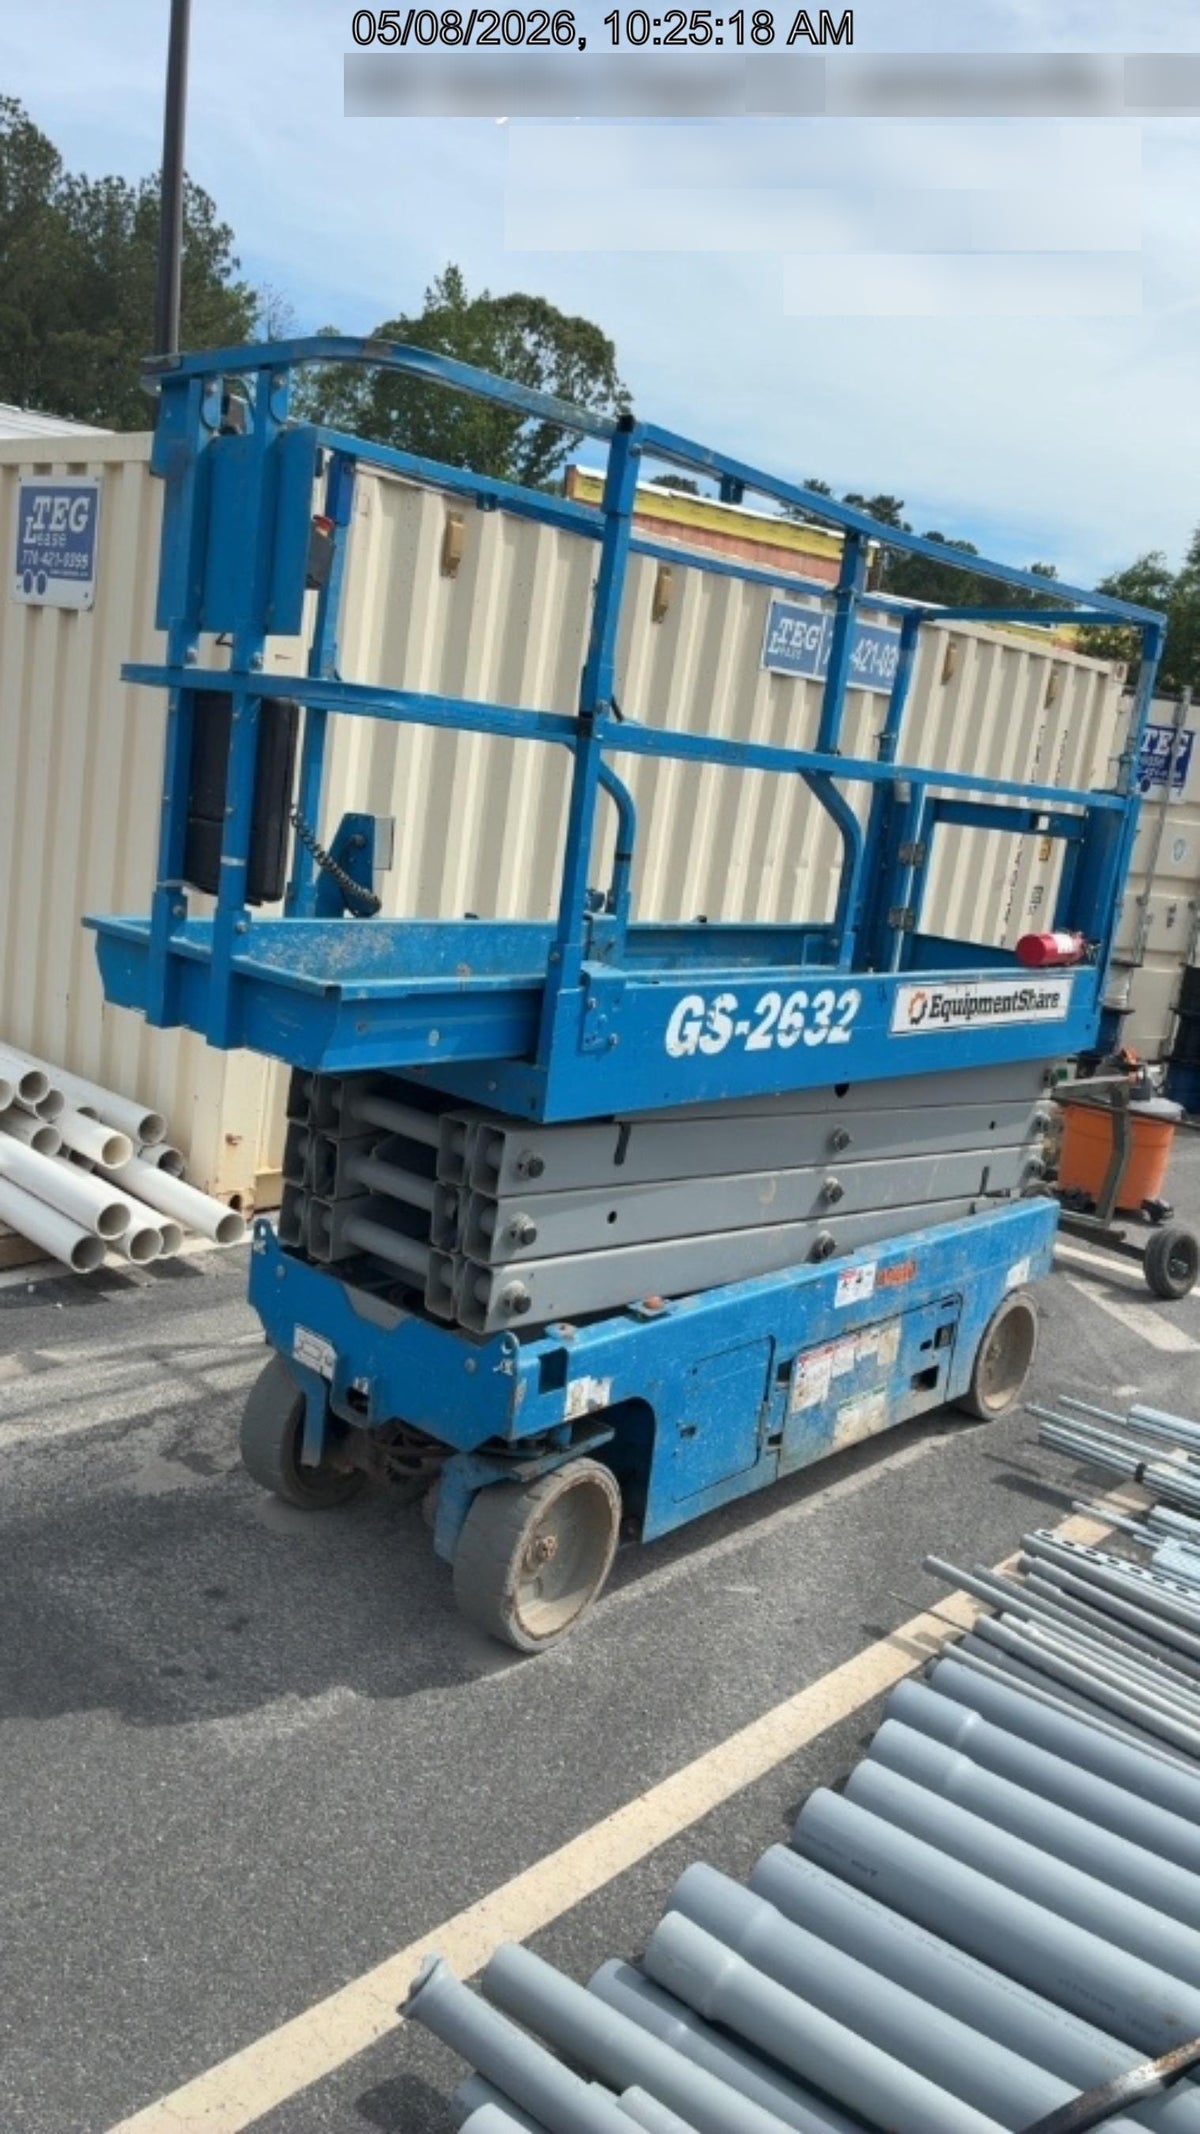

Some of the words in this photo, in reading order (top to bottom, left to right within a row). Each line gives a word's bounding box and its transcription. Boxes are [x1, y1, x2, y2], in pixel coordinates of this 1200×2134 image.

[33, 495, 91, 533] TEG
[779, 617, 821, 651] TEG
[664, 987, 862, 1059] GS-2632
[928, 987, 1061, 1024] EquipmentShare
